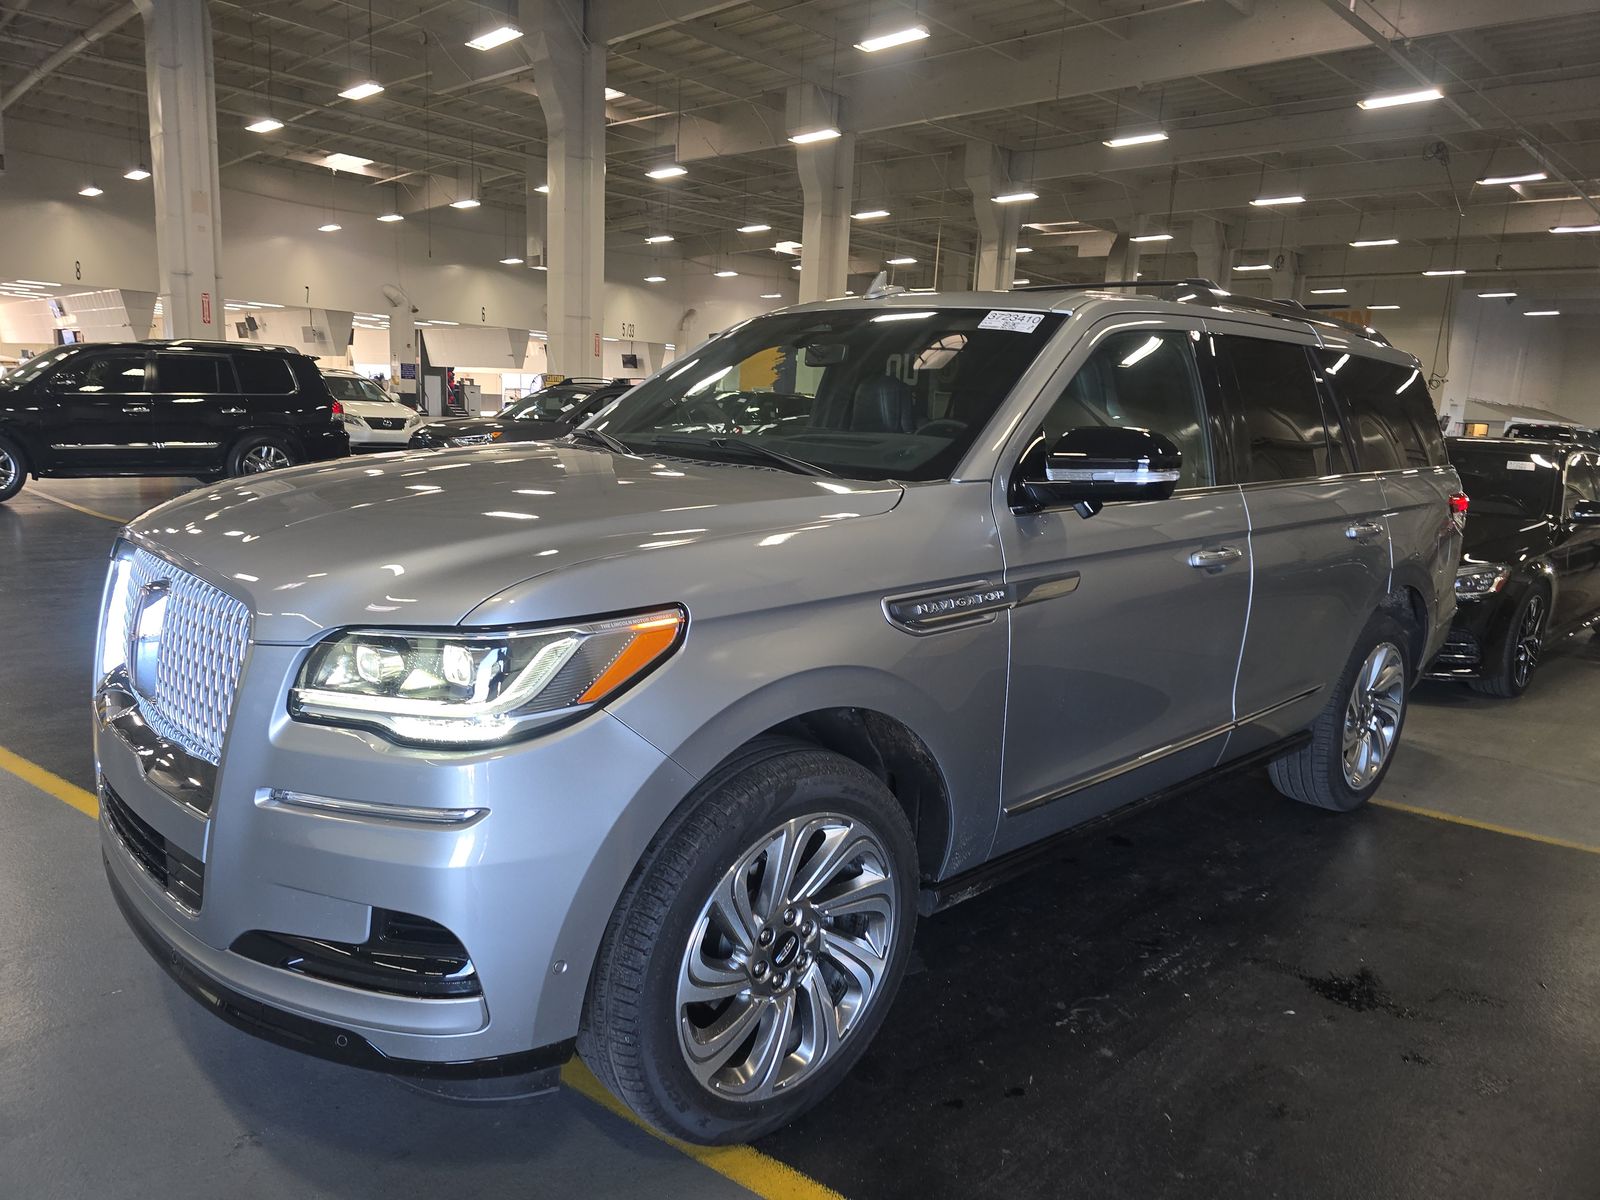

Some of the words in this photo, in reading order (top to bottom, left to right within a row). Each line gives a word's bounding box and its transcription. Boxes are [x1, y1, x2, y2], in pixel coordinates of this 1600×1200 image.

[75, 260, 81, 281] 8
[481, 306, 486, 322] 6
[988, 312, 1041, 324] 3723410
[916, 590, 1005, 614] NAVIGATOR
[611, 619, 632, 628] LINCOLN
[632, 616, 650, 625] MOTOR
